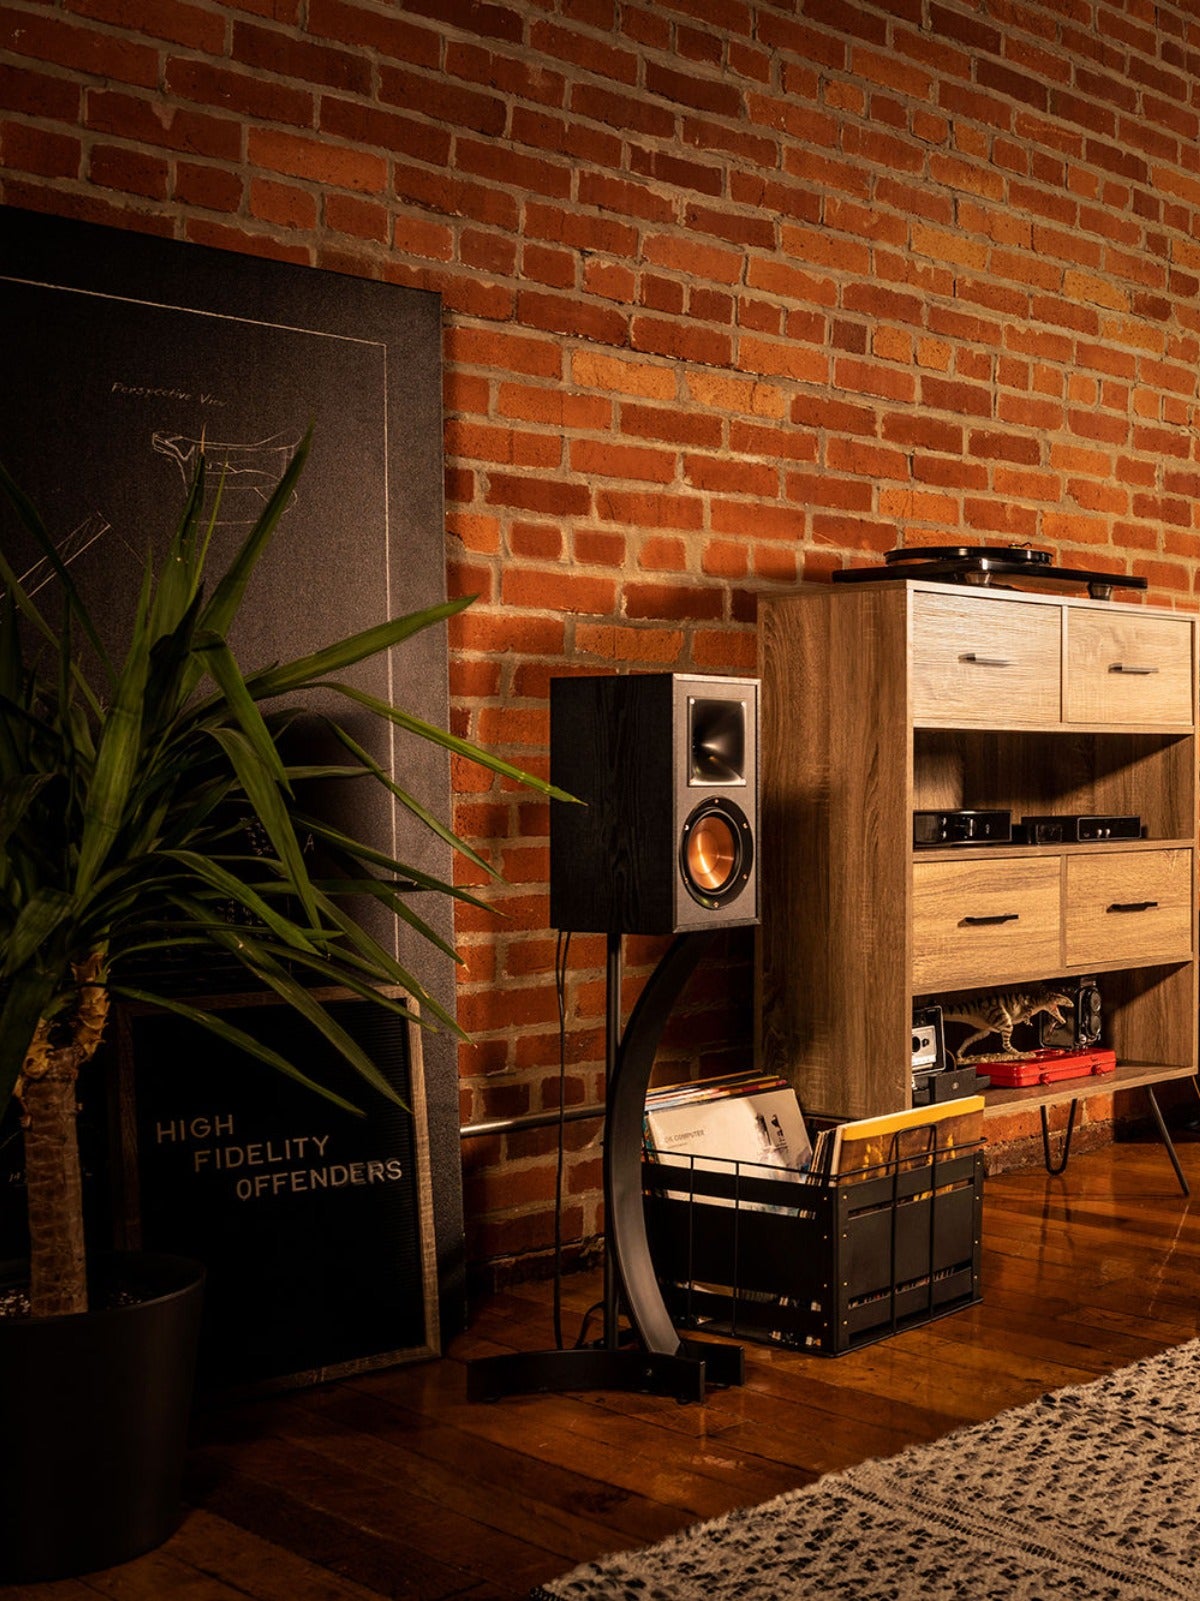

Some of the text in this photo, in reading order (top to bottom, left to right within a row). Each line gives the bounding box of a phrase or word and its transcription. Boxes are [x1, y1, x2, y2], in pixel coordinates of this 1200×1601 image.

[156, 1114, 234, 1144] HIGH
[194, 1135, 330, 1173] FIDELITY
[236, 1160, 403, 1201] OFFENDERS
